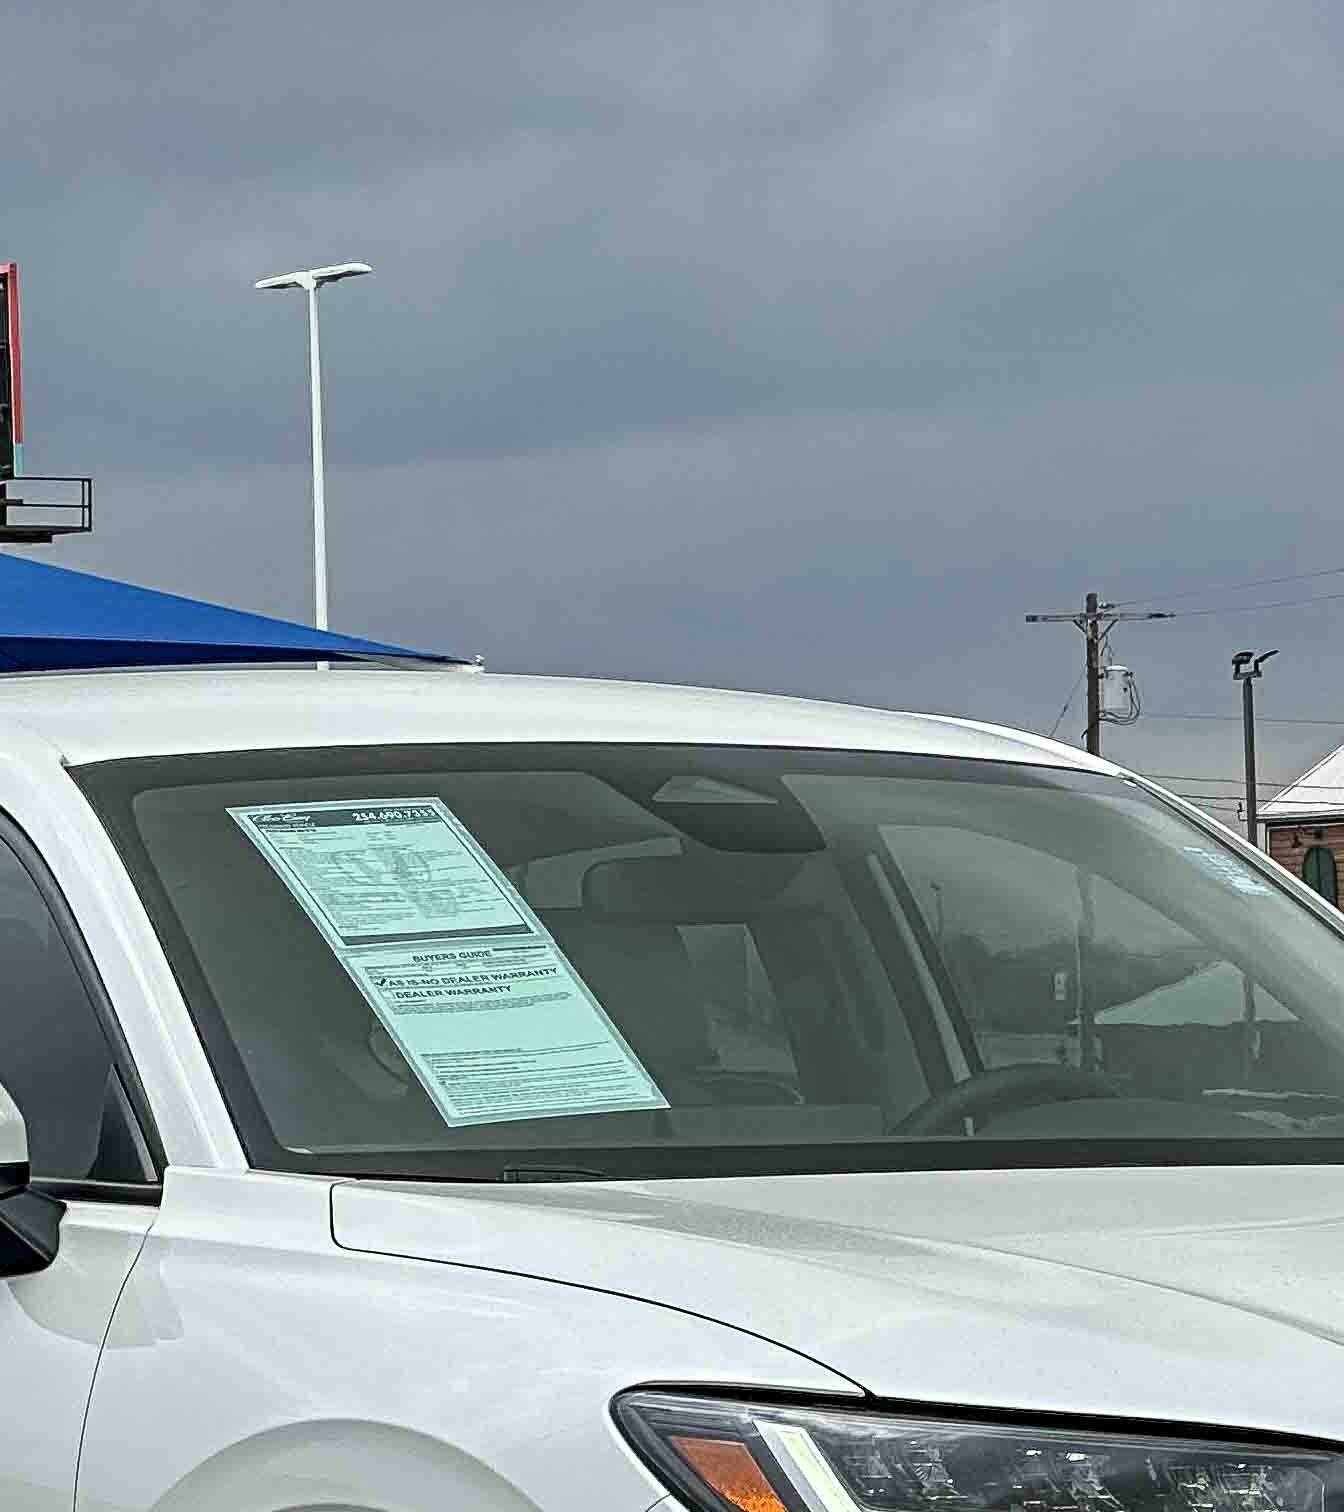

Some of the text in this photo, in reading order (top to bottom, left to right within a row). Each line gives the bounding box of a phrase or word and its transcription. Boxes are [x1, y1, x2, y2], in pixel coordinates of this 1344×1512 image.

[412, 953, 457, 964] BUYERS
[458, 950, 492, 960] GUIDE
[441, 974, 490, 985] DEALER
[490, 967, 558, 981] WARRANTY
[395, 985, 512, 1000] DEALER WARRANTY
